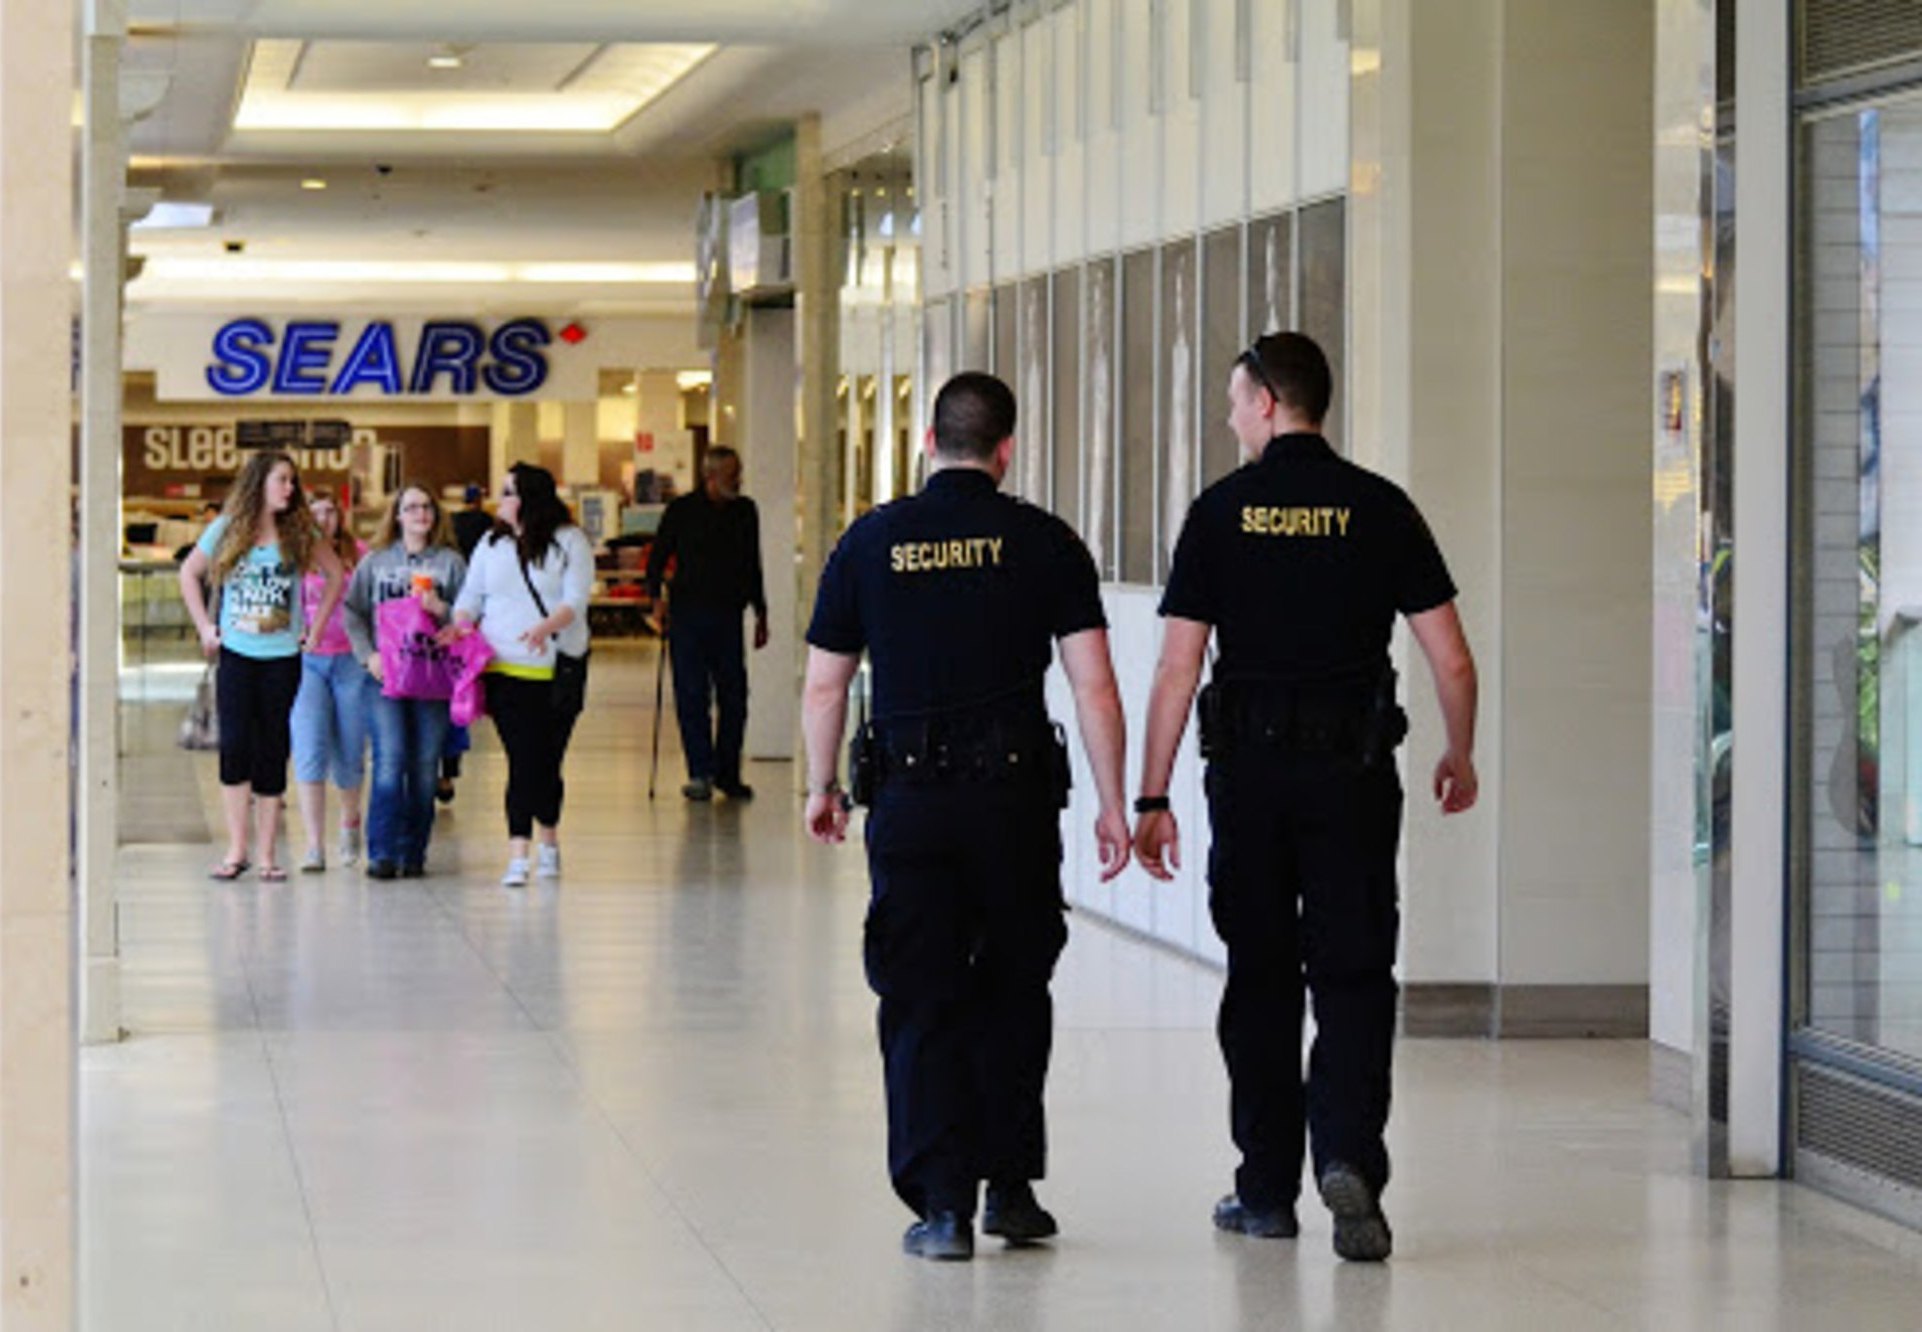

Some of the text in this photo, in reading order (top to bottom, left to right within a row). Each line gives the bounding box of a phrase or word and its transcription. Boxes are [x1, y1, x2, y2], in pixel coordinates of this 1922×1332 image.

[205, 317, 553, 396] SEARS
[1242, 505, 1351, 537] SECURITY
[890, 536, 1003, 572] SECURITY
